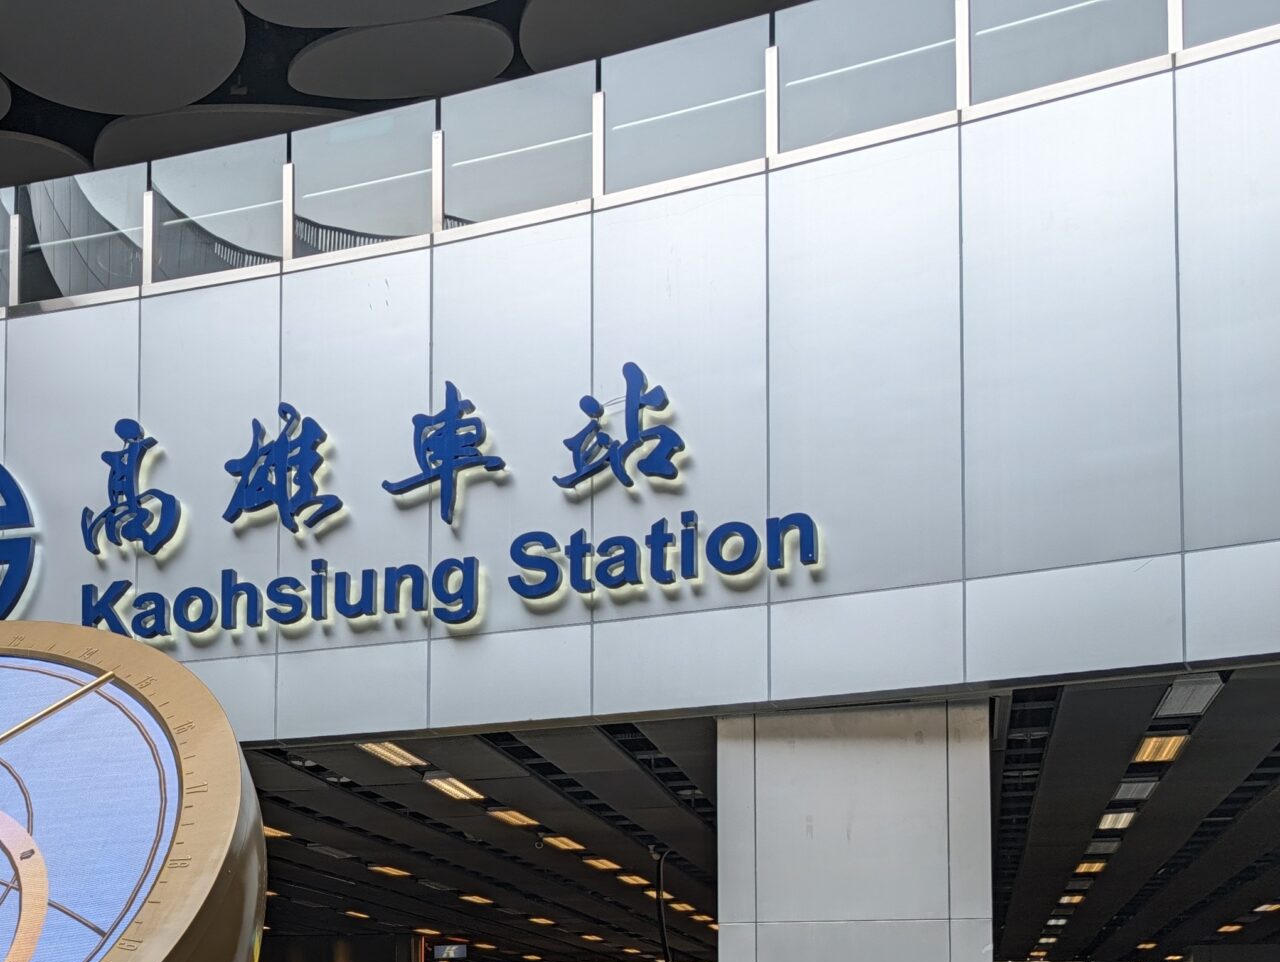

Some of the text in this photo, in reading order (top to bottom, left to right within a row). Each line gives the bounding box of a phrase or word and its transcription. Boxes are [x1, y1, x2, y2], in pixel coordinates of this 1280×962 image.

[81, 362, 687, 555] 高雄車站
[81, 509, 818, 639] Kaohsiung Station
